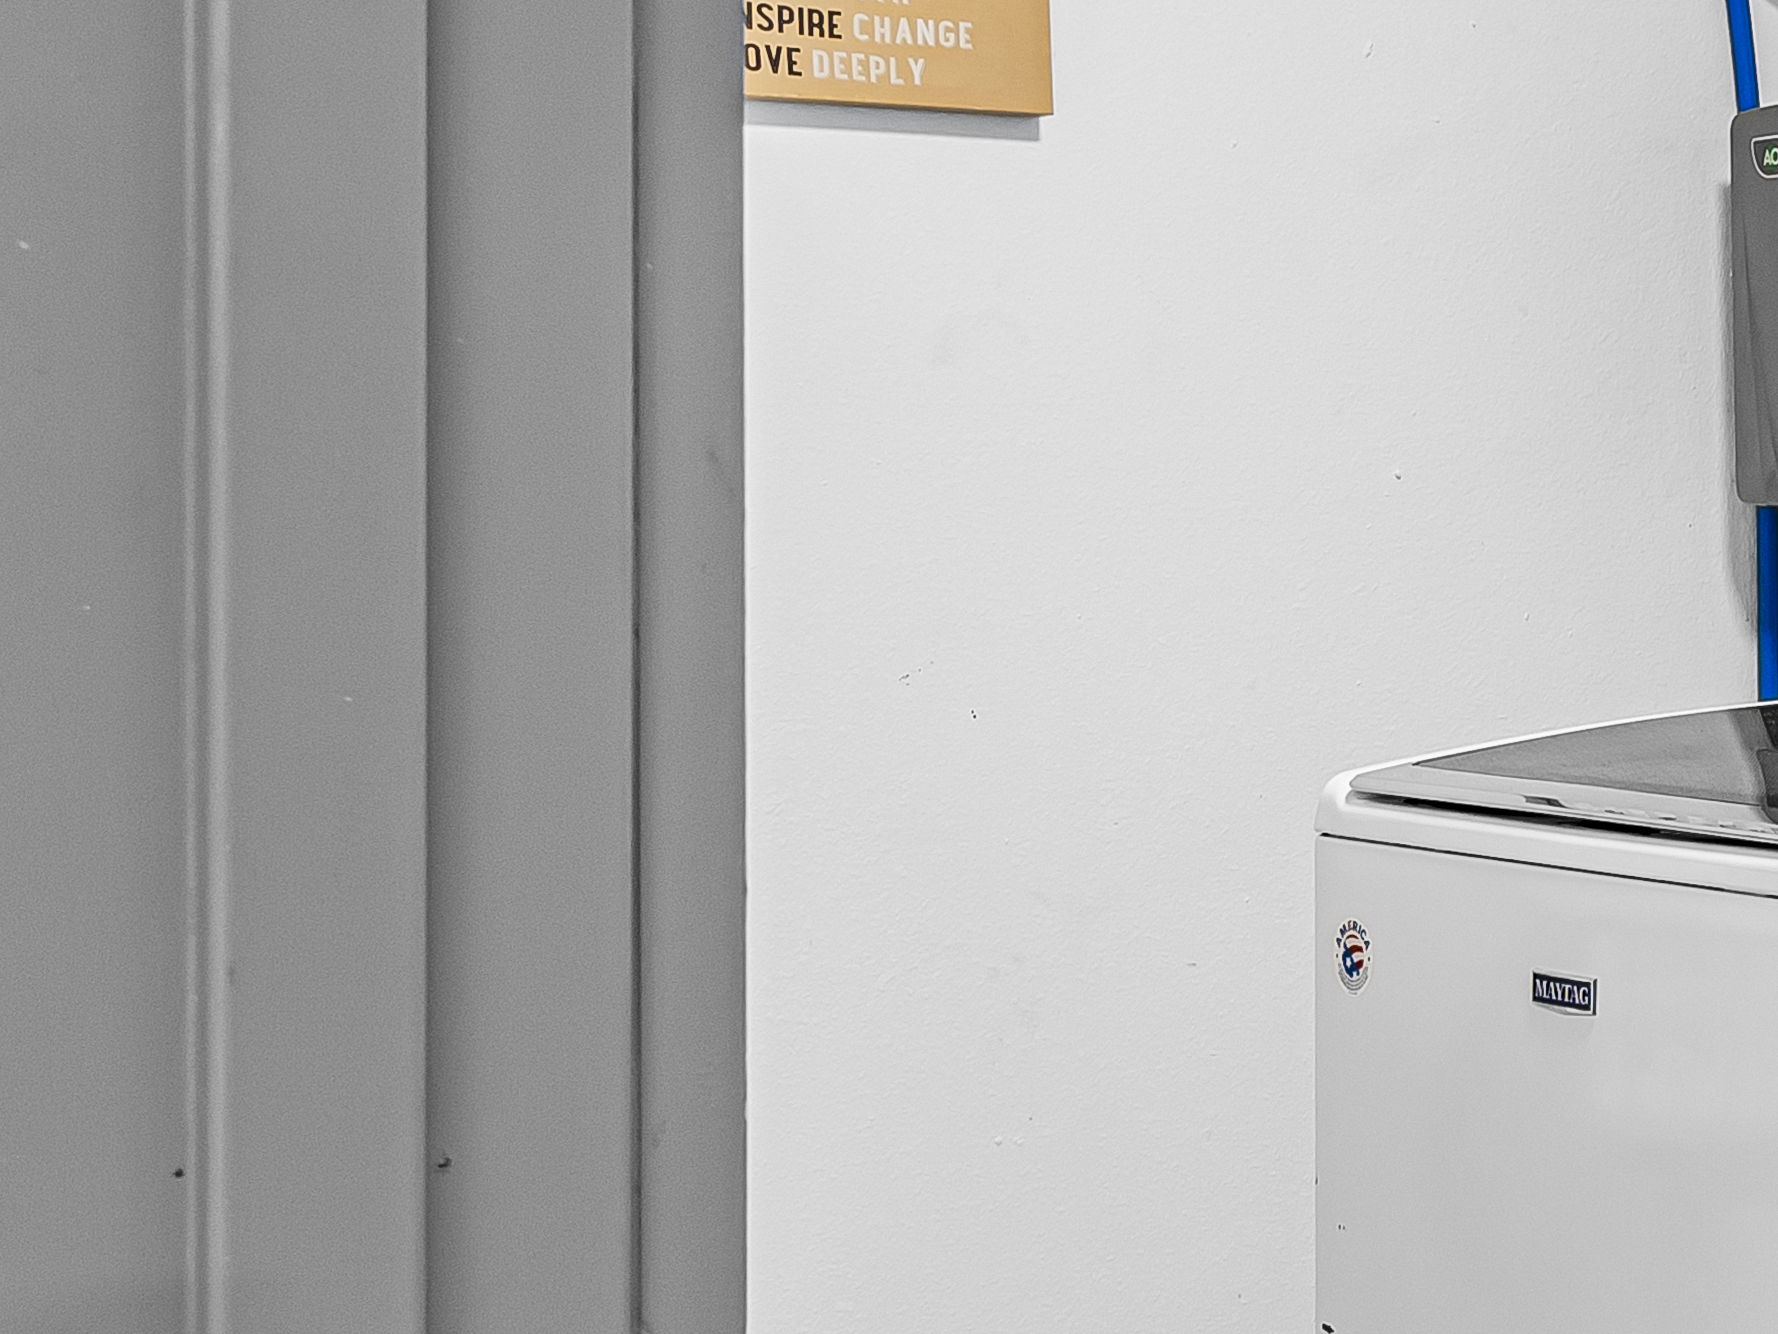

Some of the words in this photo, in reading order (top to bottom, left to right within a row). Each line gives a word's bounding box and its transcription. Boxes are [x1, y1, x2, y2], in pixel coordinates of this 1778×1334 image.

[852, 12, 973, 50] CHANGE
[744, 42, 803, 77] OVE
[811, 48, 926, 86] DEEPLY
[1335, 919, 1371, 952] AMERICA
[1535, 978, 1590, 1005] MAYTAG
